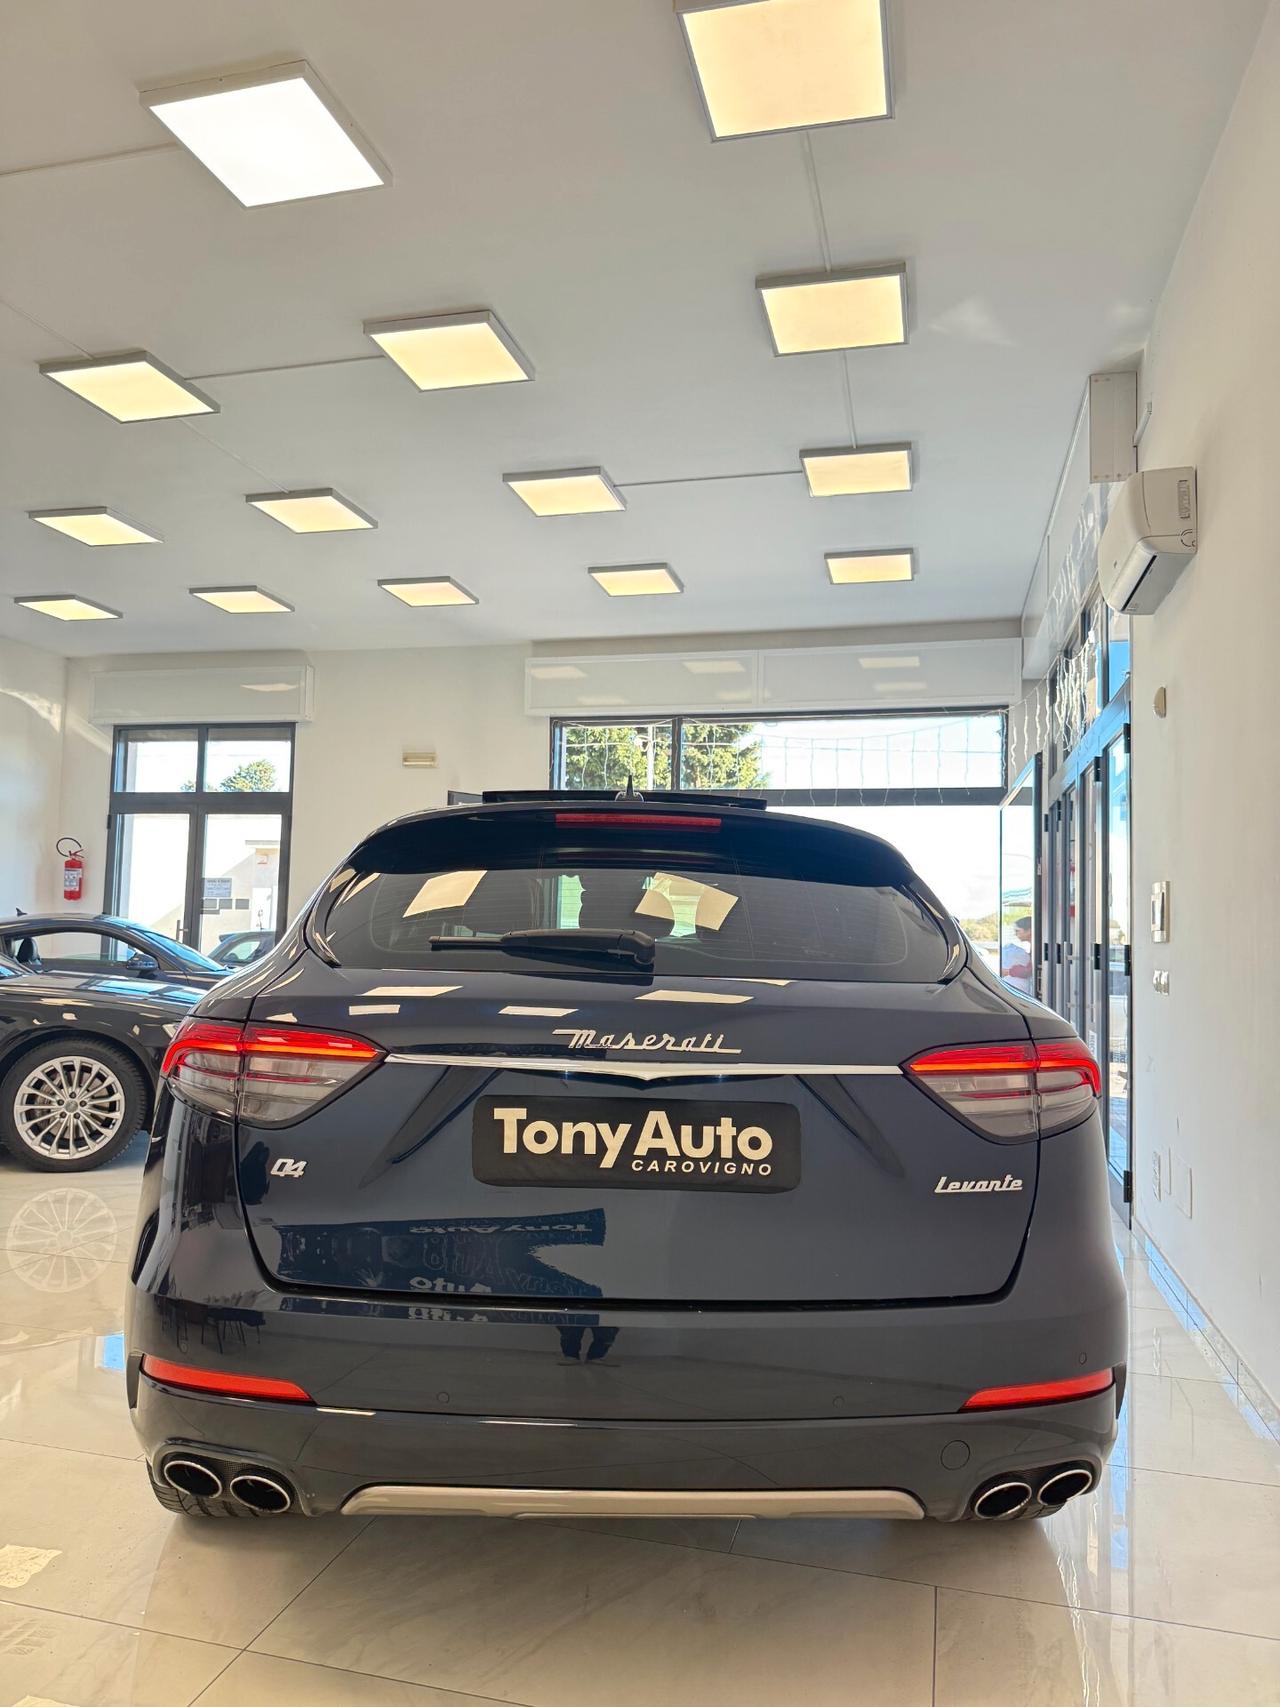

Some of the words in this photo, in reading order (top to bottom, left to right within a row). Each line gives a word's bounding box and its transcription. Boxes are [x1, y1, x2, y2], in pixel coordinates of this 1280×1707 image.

[552, 1029, 743, 1054] Maserati
[493, 1107, 632, 1169] Tony
[633, 1110, 773, 1161] Auto
[270, 1158, 307, 1178] Q4
[631, 1159, 773, 1176] CAROVIGNO
[934, 1174, 1023, 1194] Levante
